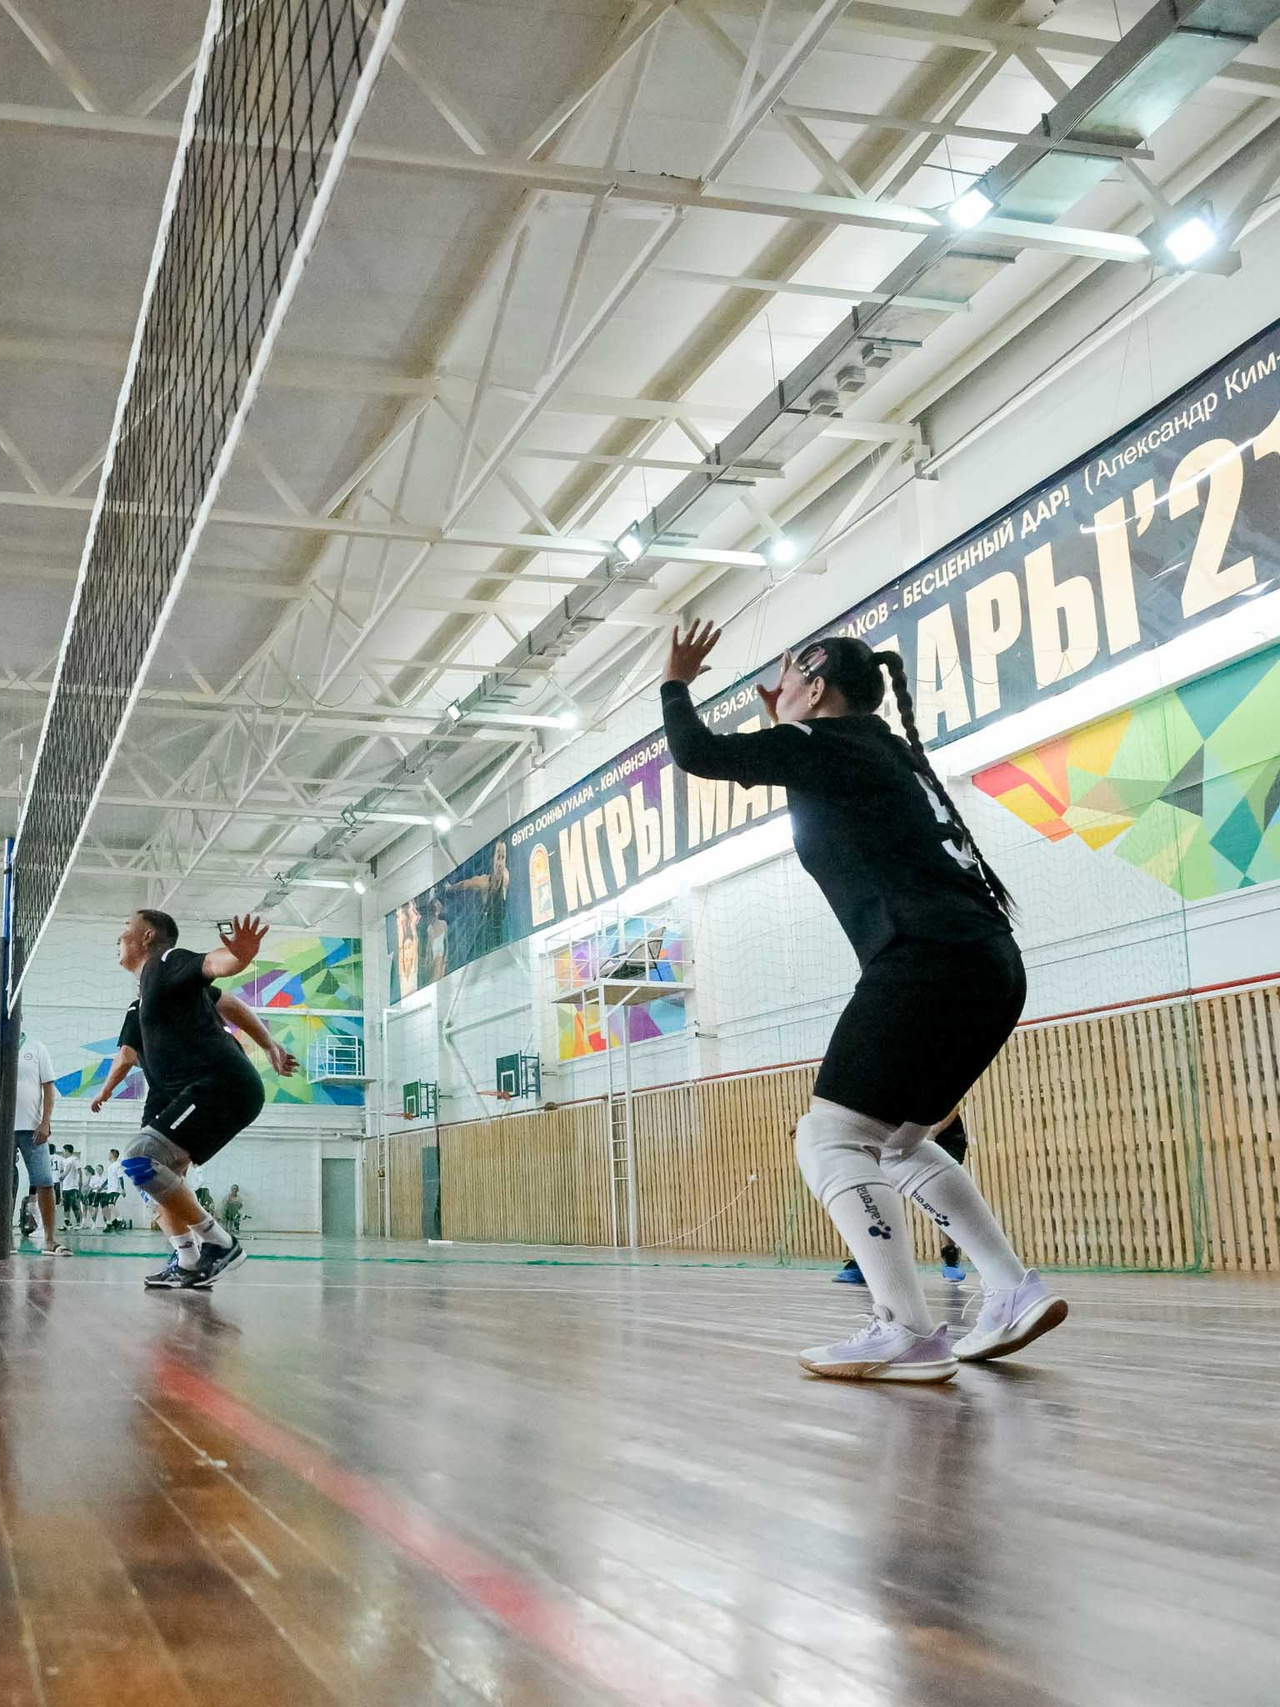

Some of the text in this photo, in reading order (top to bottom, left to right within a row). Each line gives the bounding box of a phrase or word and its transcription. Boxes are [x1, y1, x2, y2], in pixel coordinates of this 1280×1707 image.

[903, 517, 1014, 609] БЕСЦЕННЫЙ
[1020, 484, 1071, 540] ДАР!
[1084, 391, 1219, 495] (Александр
[558, 764, 676, 912] ИГРЫ
